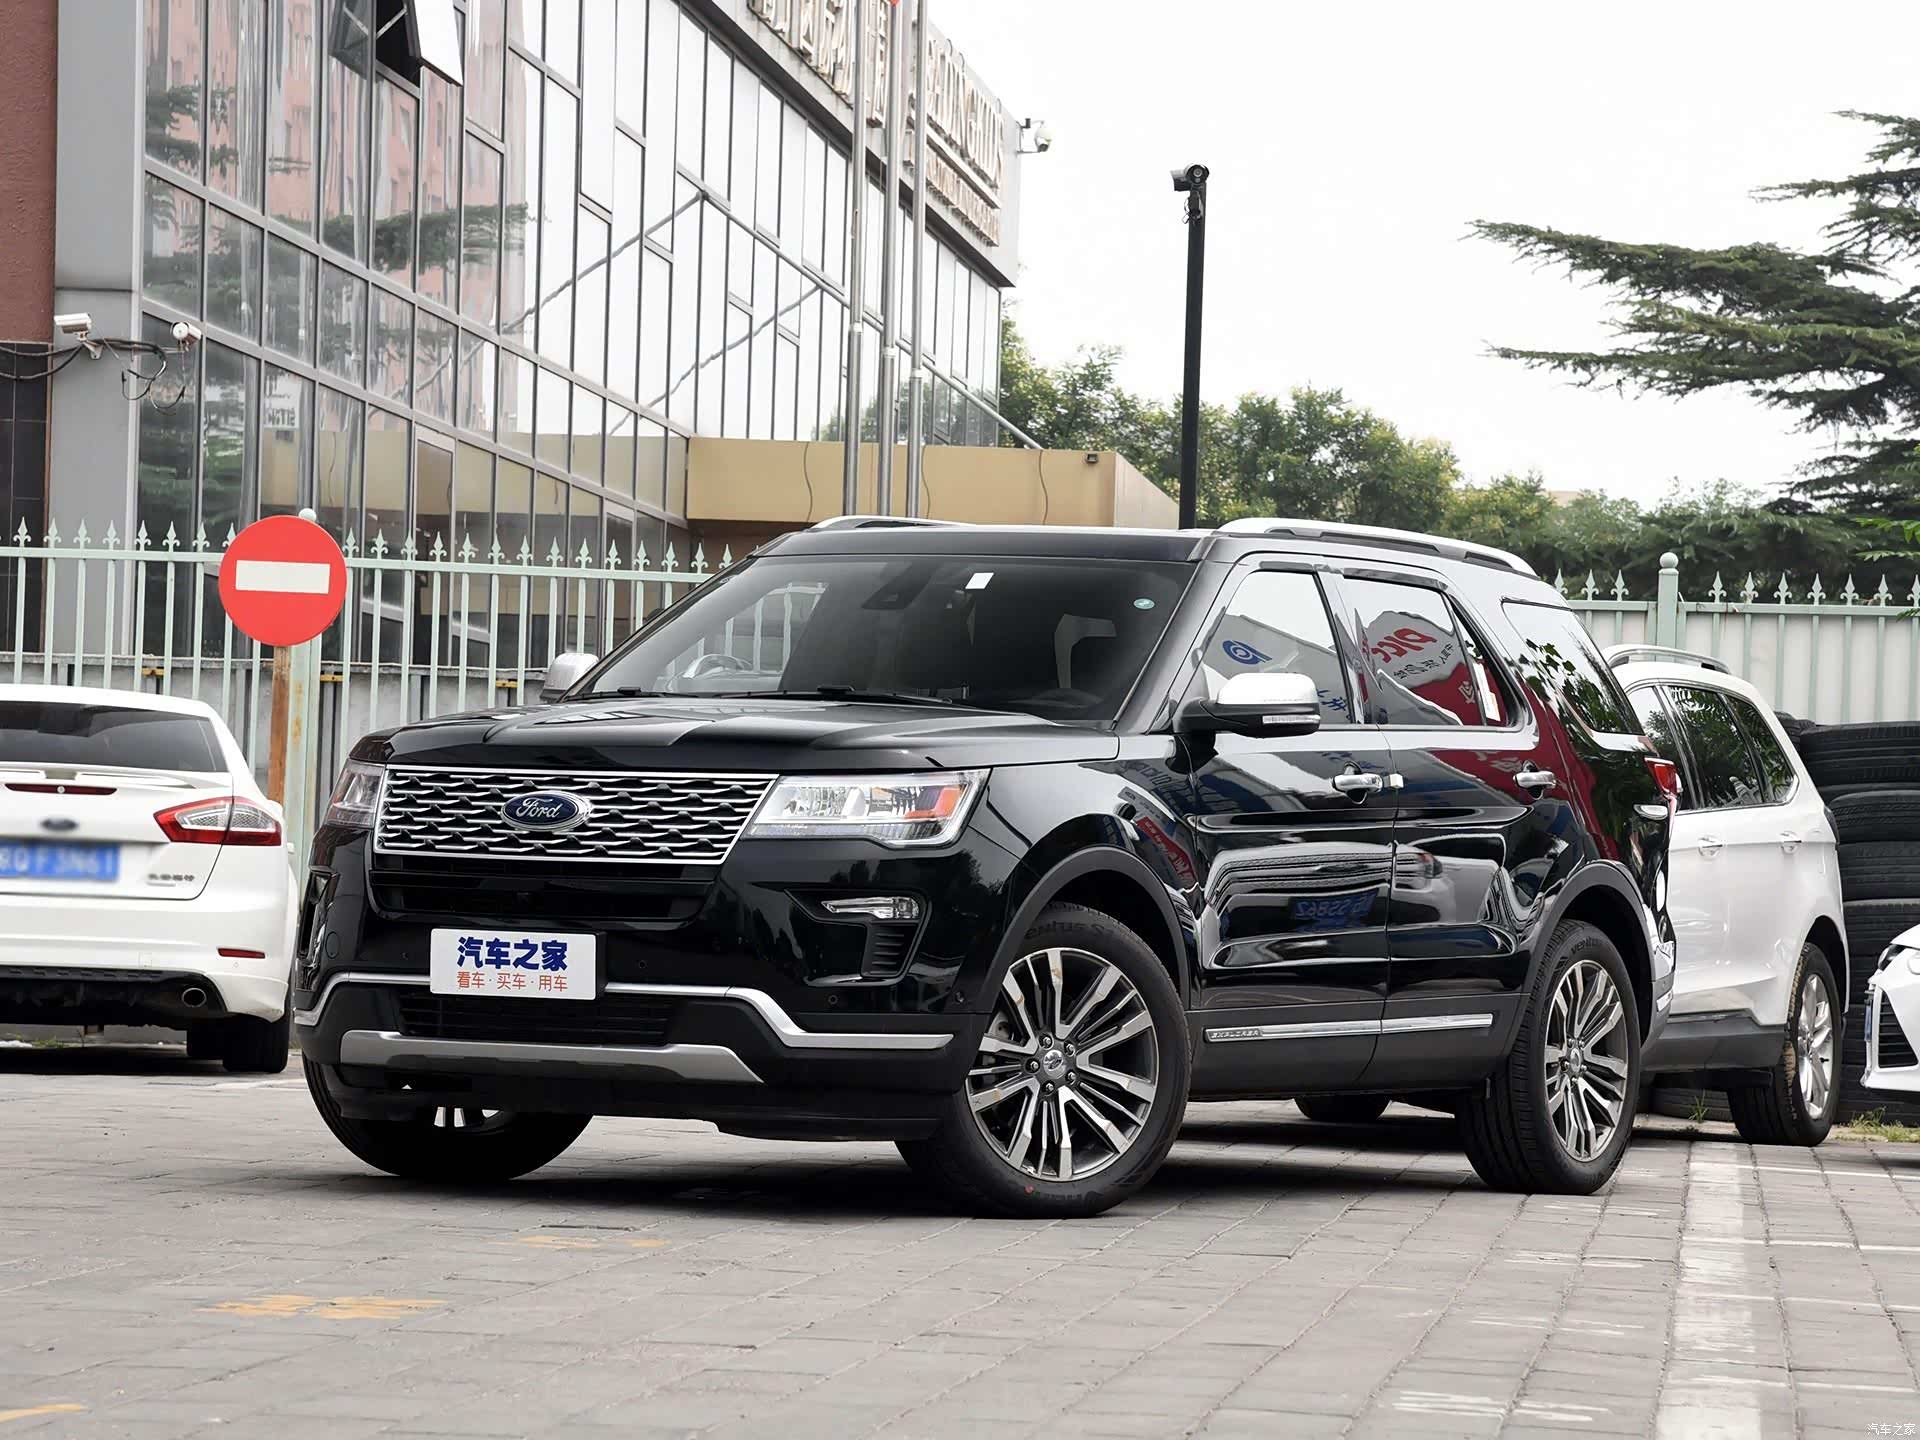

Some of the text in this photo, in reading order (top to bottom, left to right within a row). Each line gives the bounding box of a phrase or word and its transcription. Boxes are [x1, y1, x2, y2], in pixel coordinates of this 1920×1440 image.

[515, 797, 563, 818] Ford
[457, 936, 568, 971] 汽车之家
